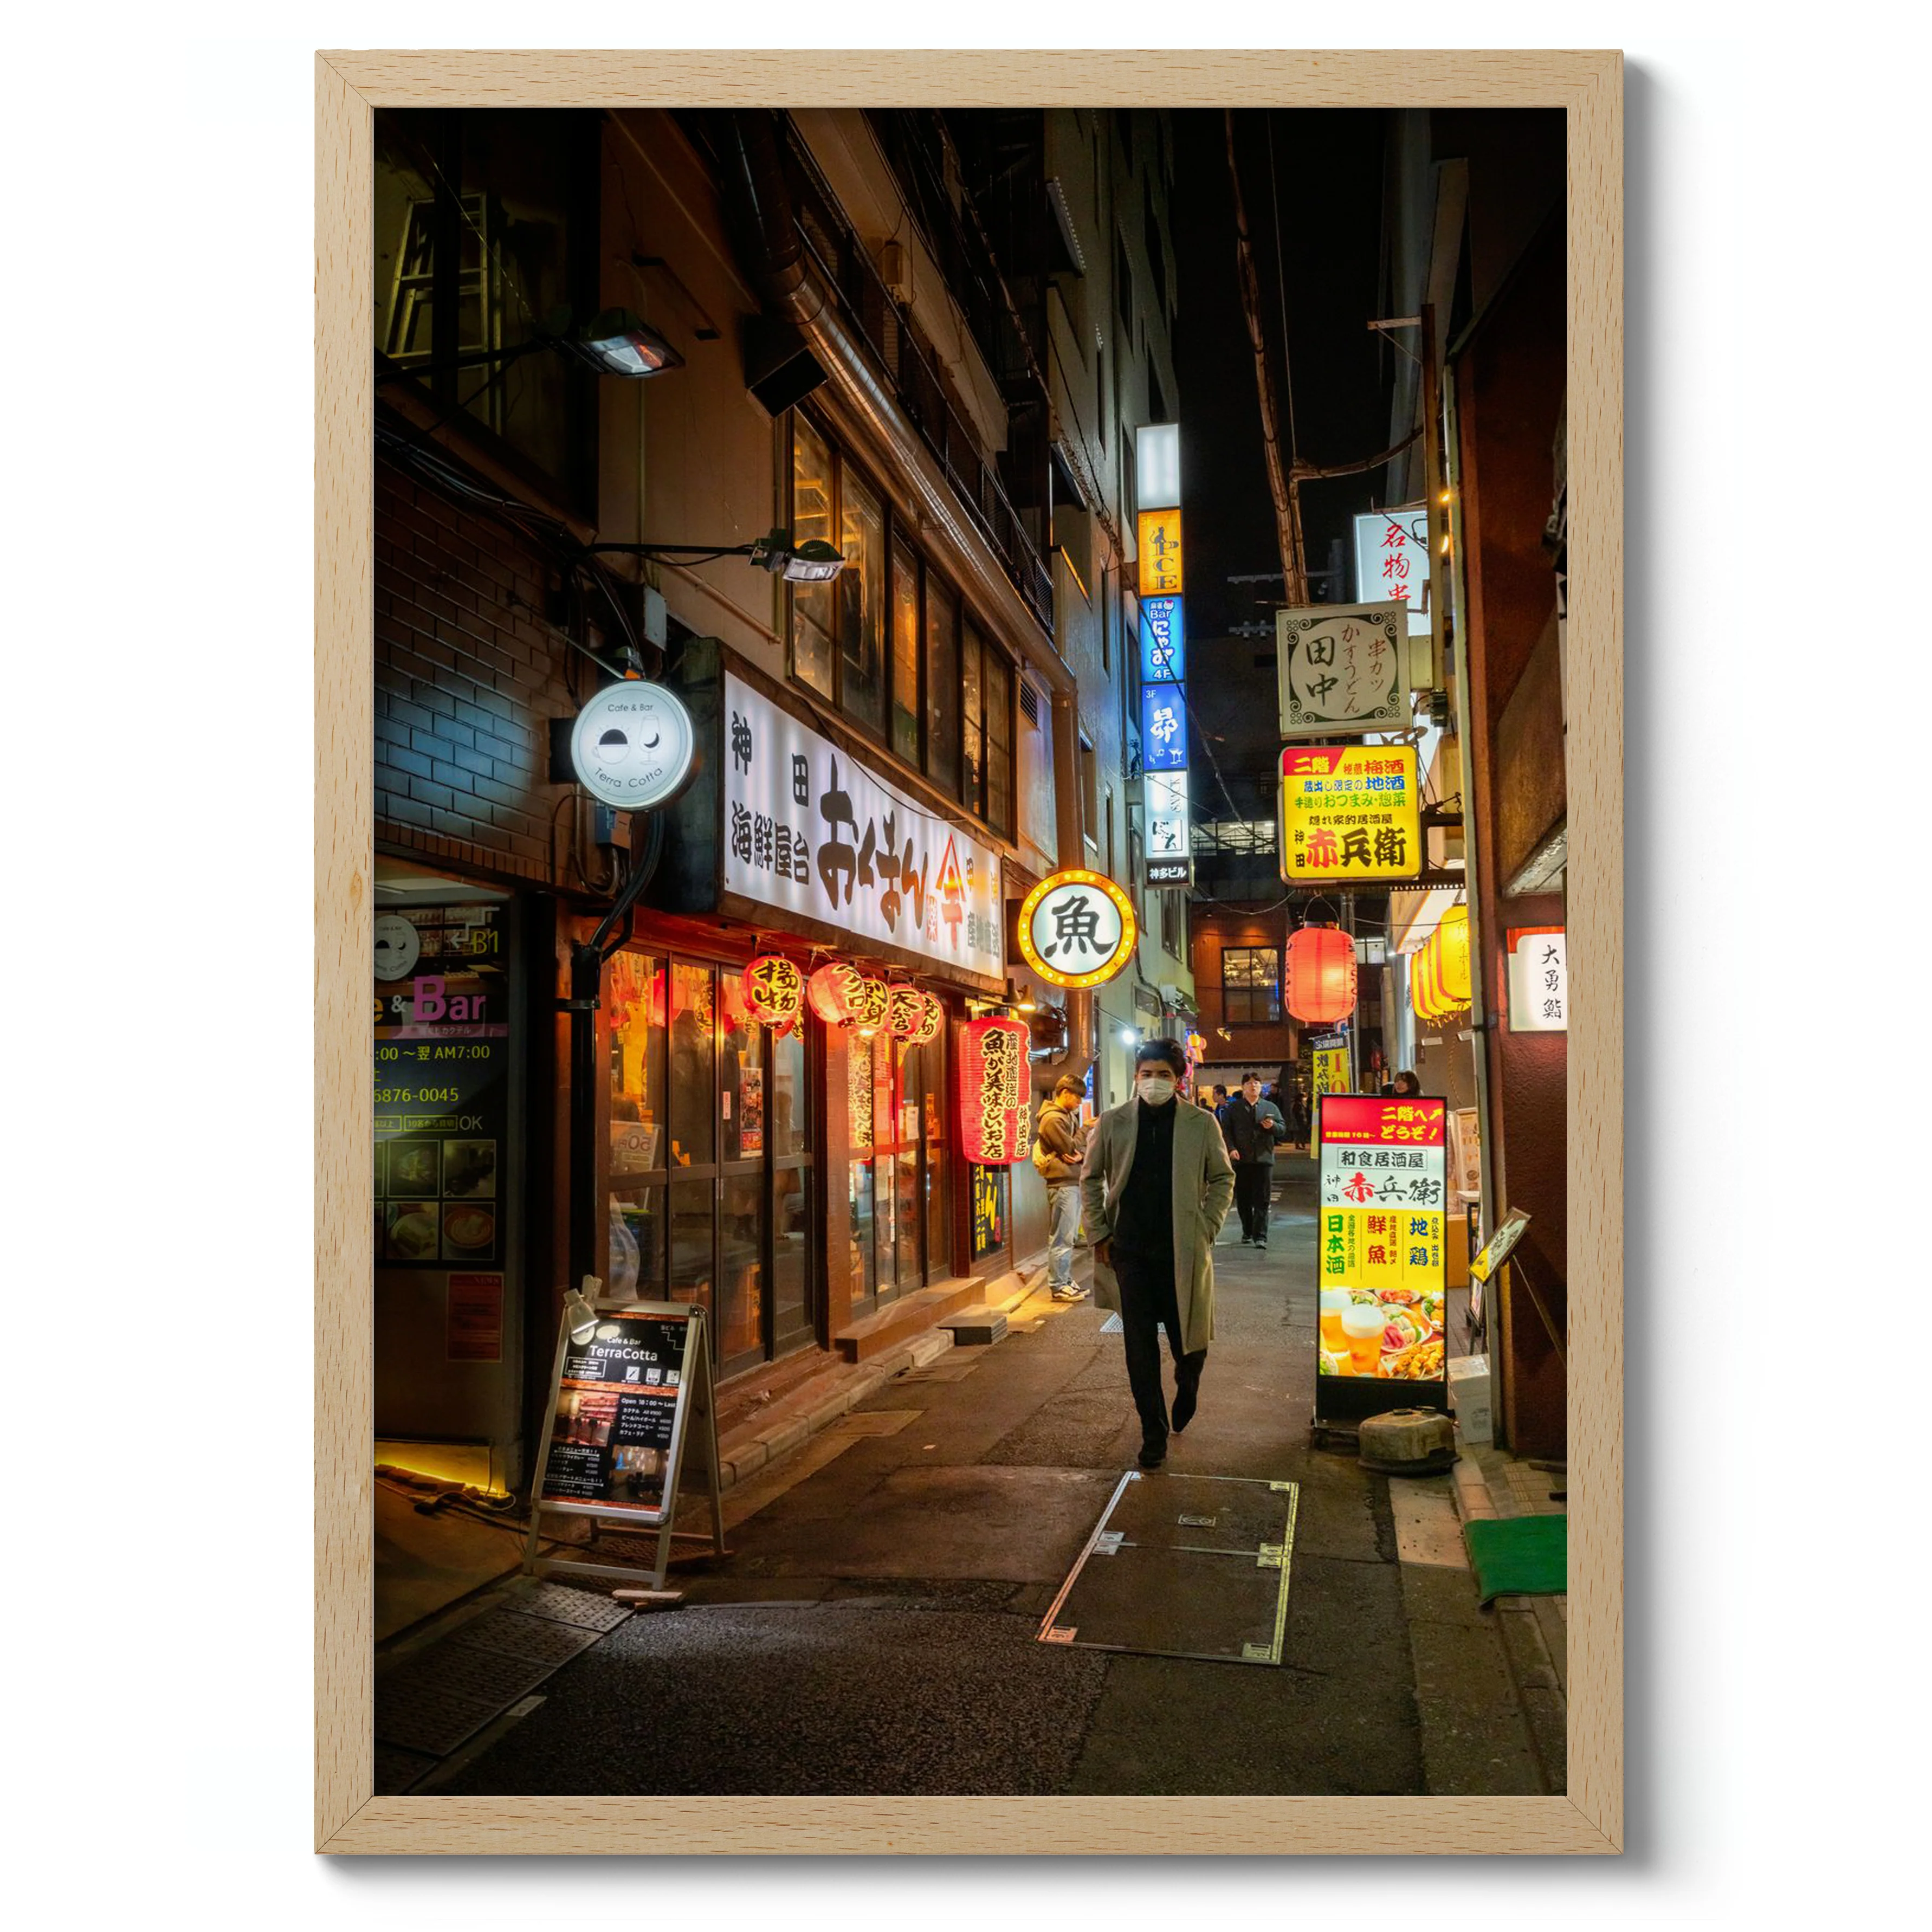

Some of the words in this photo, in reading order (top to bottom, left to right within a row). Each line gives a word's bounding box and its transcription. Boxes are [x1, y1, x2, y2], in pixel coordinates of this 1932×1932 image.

[1150, 610, 1171, 618] Bar
[1154, 669, 1171, 680] 4F
[1306, 636, 1338, 707] 田中
[1342, 625, 1360, 714] かすうどん
[1368, 638, 1387, 692] 串カツ
[608, 704, 629, 712] Cafe
[1146, 689, 1156, 699] 3F
[595, 767, 622, 788] Terra
[628, 767, 663, 788] Cotta
[1294, 757, 1330, 774] 二階
[732, 800, 810, 885] 海鮮屋台
[817, 753, 928, 933] おくまん
[1294, 829, 1305, 868] 神田
[1307, 827, 1407, 868] 赤兵衛
[471, 931, 498, 954] B1
[1044, 895, 1118, 958] 魚
[391, 995, 408, 1013] &
[414, 975, 487, 1023] Bar
[754, 960, 798, 1012] 揚物
[1542, 944, 1562, 1020] 大勇鮨
[891, 991, 920, 1030] 天ぷら
[435, 1045, 490, 1059] AM7:00
[983, 1029, 1006, 1159] 魚が美味しいお店
[459, 1116, 484, 1130] OK
[1381, 1106, 1428, 1122] 二階へ
[1341, 1151, 1424, 1168] 和食居酒屋
[1342, 1172, 1442, 1205] 赤兵衛
[1326, 1214, 1345, 1275] 日本酒
[1367, 1216, 1387, 1265] 鮮魚
[1409, 1217, 1429, 1267] 地鶏
[589, 1345, 658, 1361] TerraCotta
